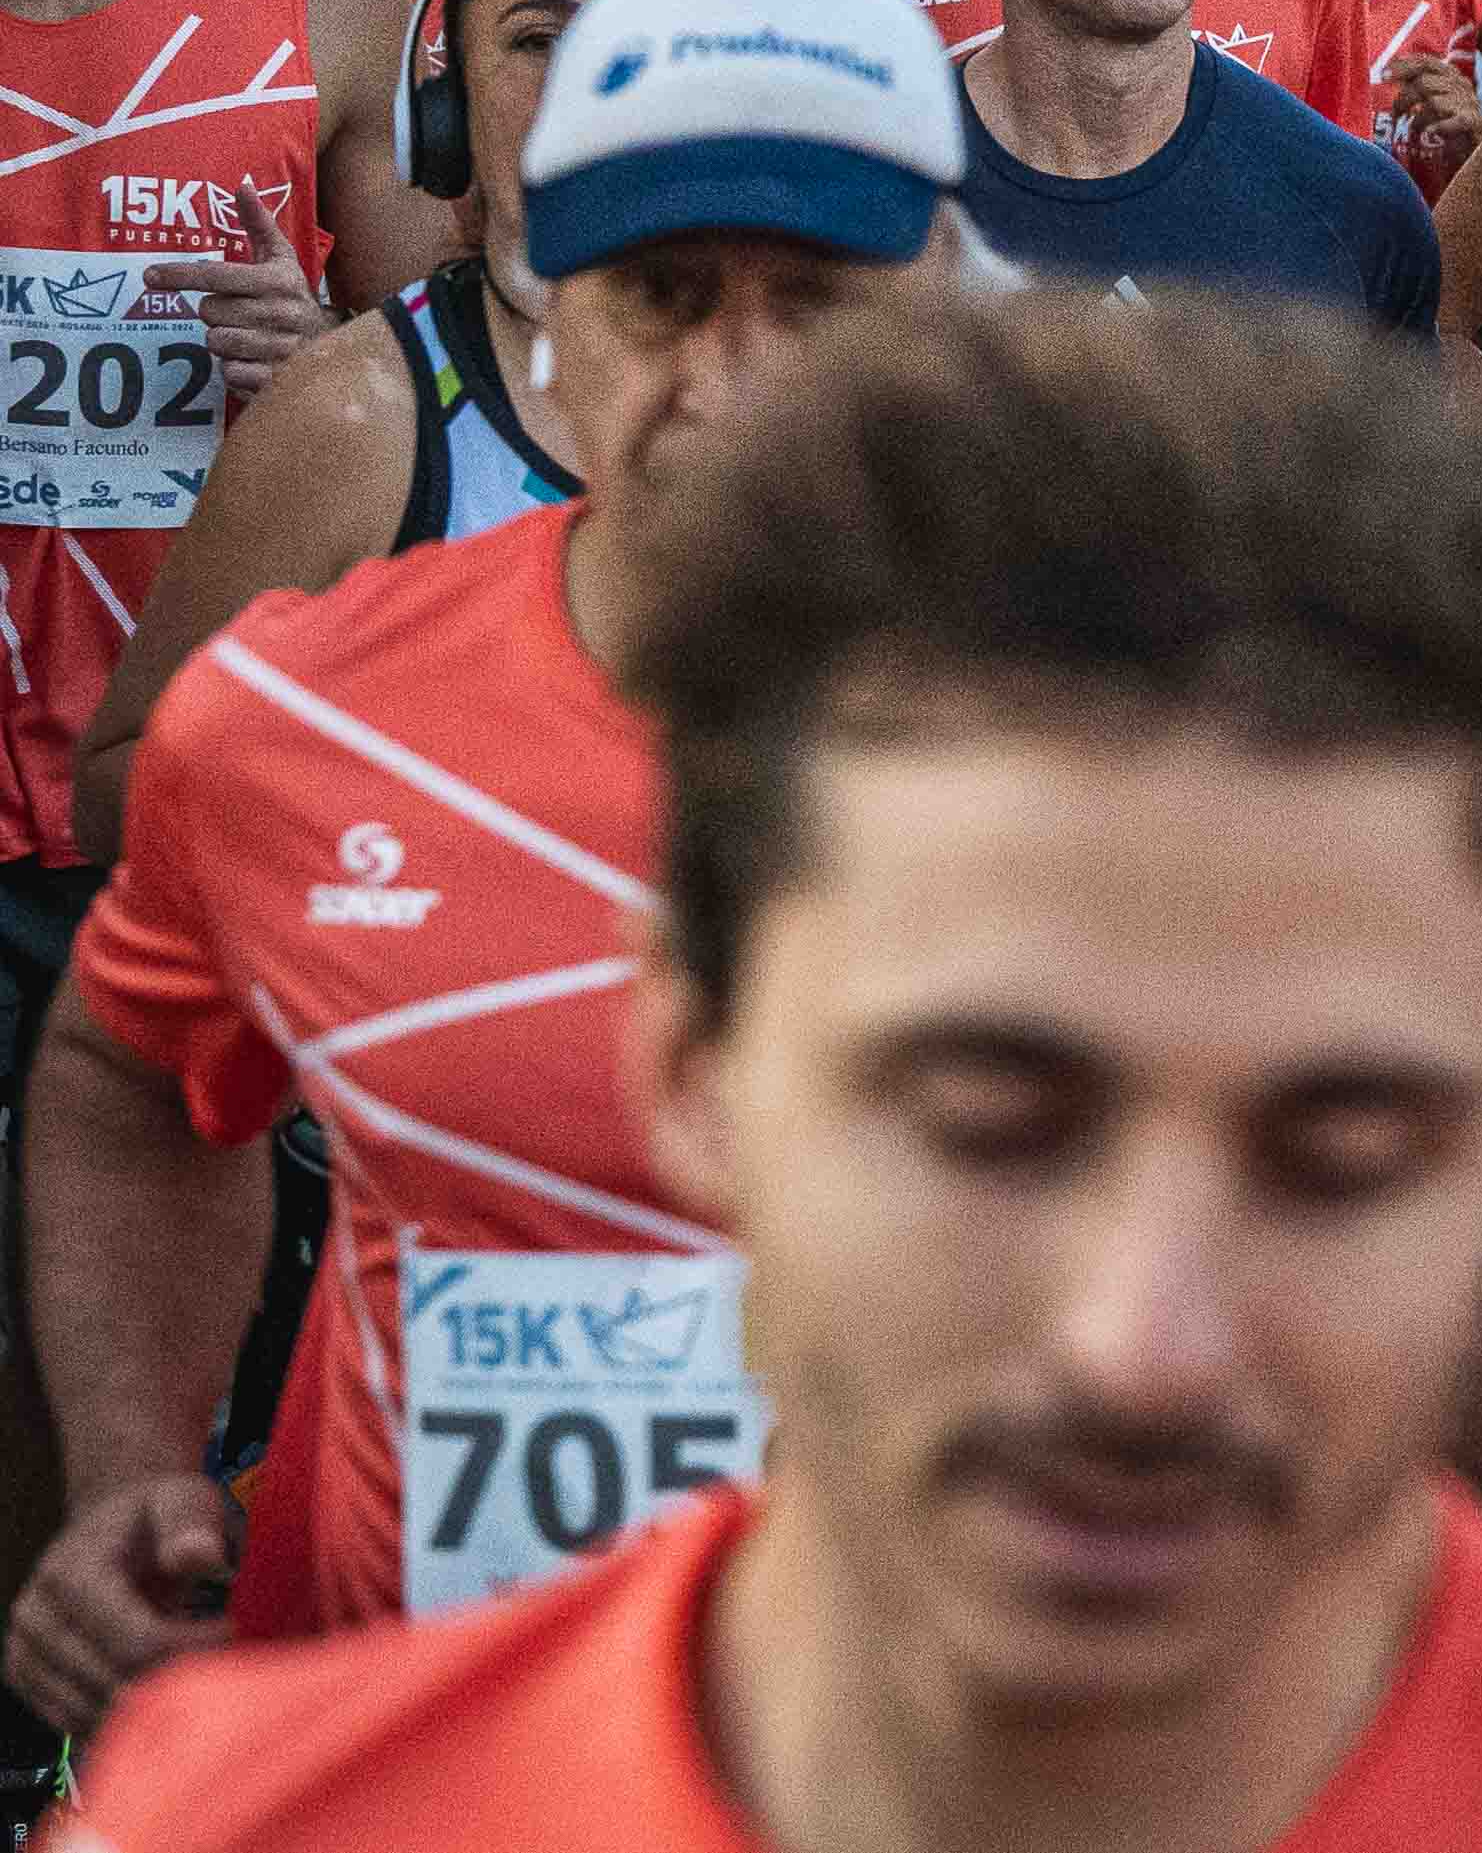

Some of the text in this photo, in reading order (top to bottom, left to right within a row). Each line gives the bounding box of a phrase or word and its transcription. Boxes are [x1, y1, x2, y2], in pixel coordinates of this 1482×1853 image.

[101, 175, 203, 229] 15K
[110, 228, 245, 253] PUERTO NOR
[142, 294, 184, 314] 15K
[7, 339, 215, 430] 202
[74, 439, 150, 457] Facundo
[439, 1302, 564, 1370] 15K
